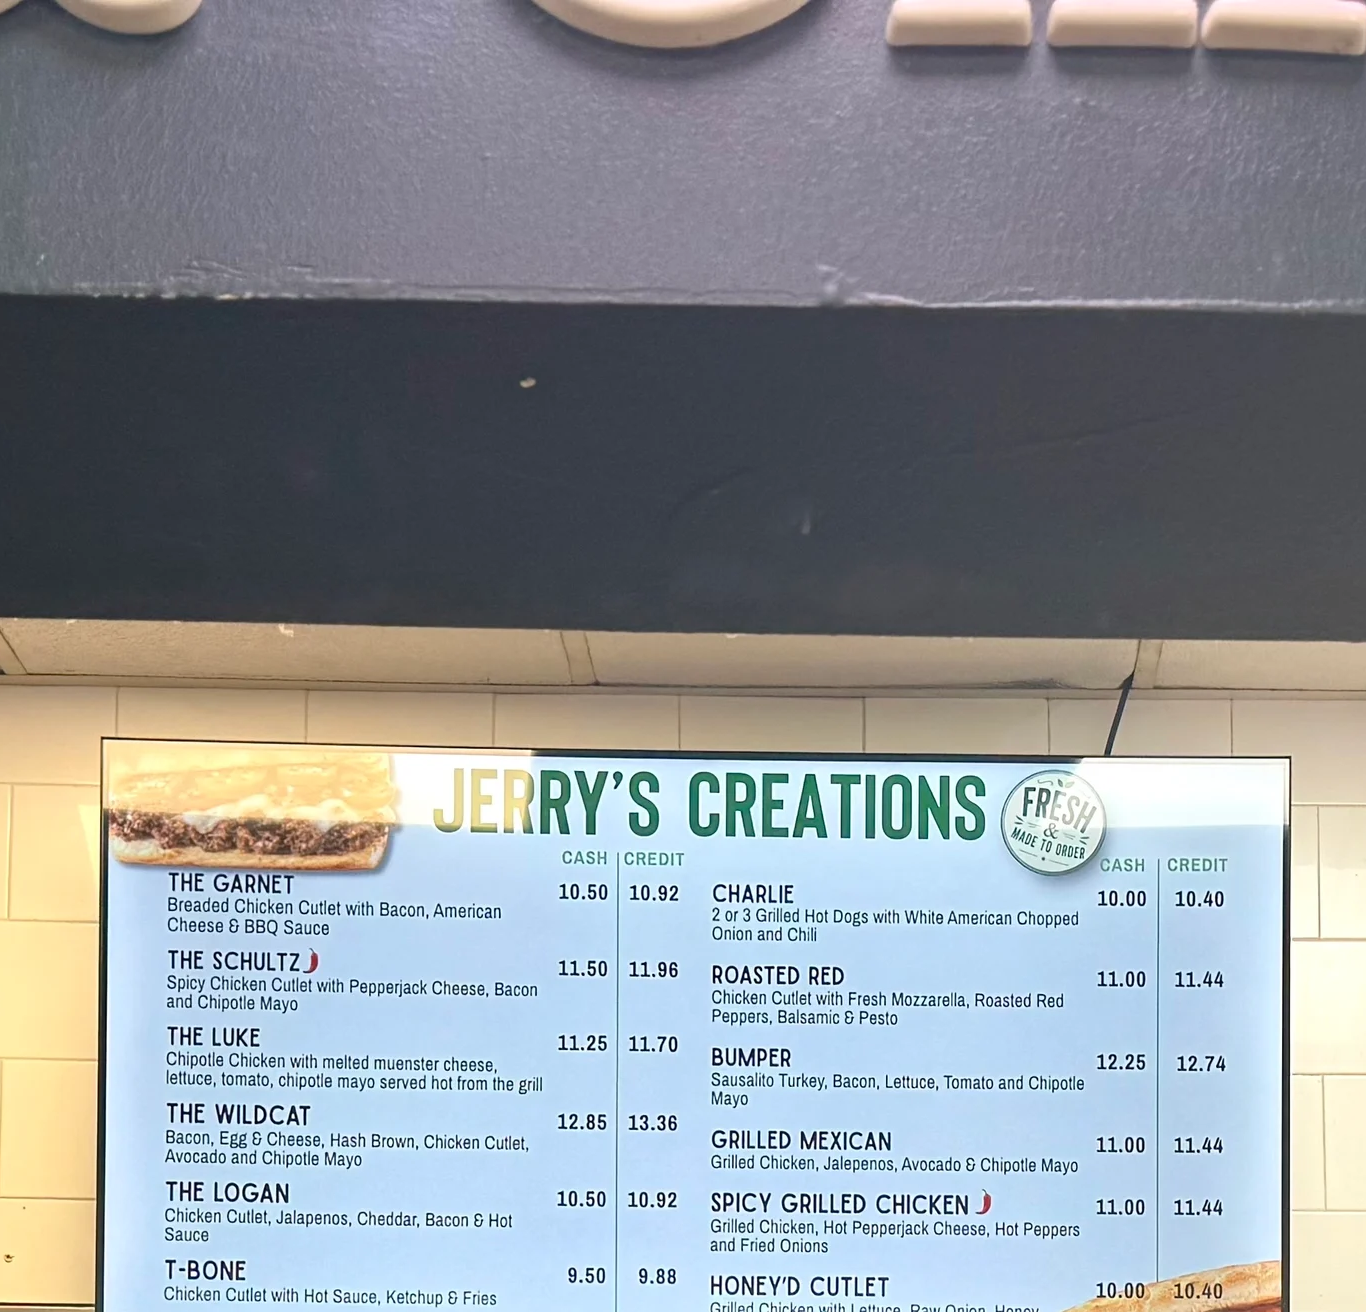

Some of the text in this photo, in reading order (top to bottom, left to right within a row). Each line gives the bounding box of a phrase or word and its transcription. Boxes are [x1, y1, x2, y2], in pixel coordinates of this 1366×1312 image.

[432, 767, 987, 841] JERRY'S CREATIONS
[1022, 787, 1097, 834] FRESH
[1043, 823, 1059, 839] &
[1010, 827, 1086, 860] MADE TO ORDER
[168, 872, 679, 901] THE GARNET 10.50 10.92
[713, 884, 1224, 907] CHARLIE 10.00 10.40
[168, 897, 501, 919] Breaded Chicken Cutlet with Bacon, American
[712, 1009, 898, 1026] Peppers, Balsamic & Pesto
[167, 1103, 677, 1131] THE WILDCAT 12.85 13.36
[711, 1192, 1223, 1216] SPICY GRILLED CHICKEN 11.44
[711, 1275, 889, 1297] HONEY'D CUTLET
